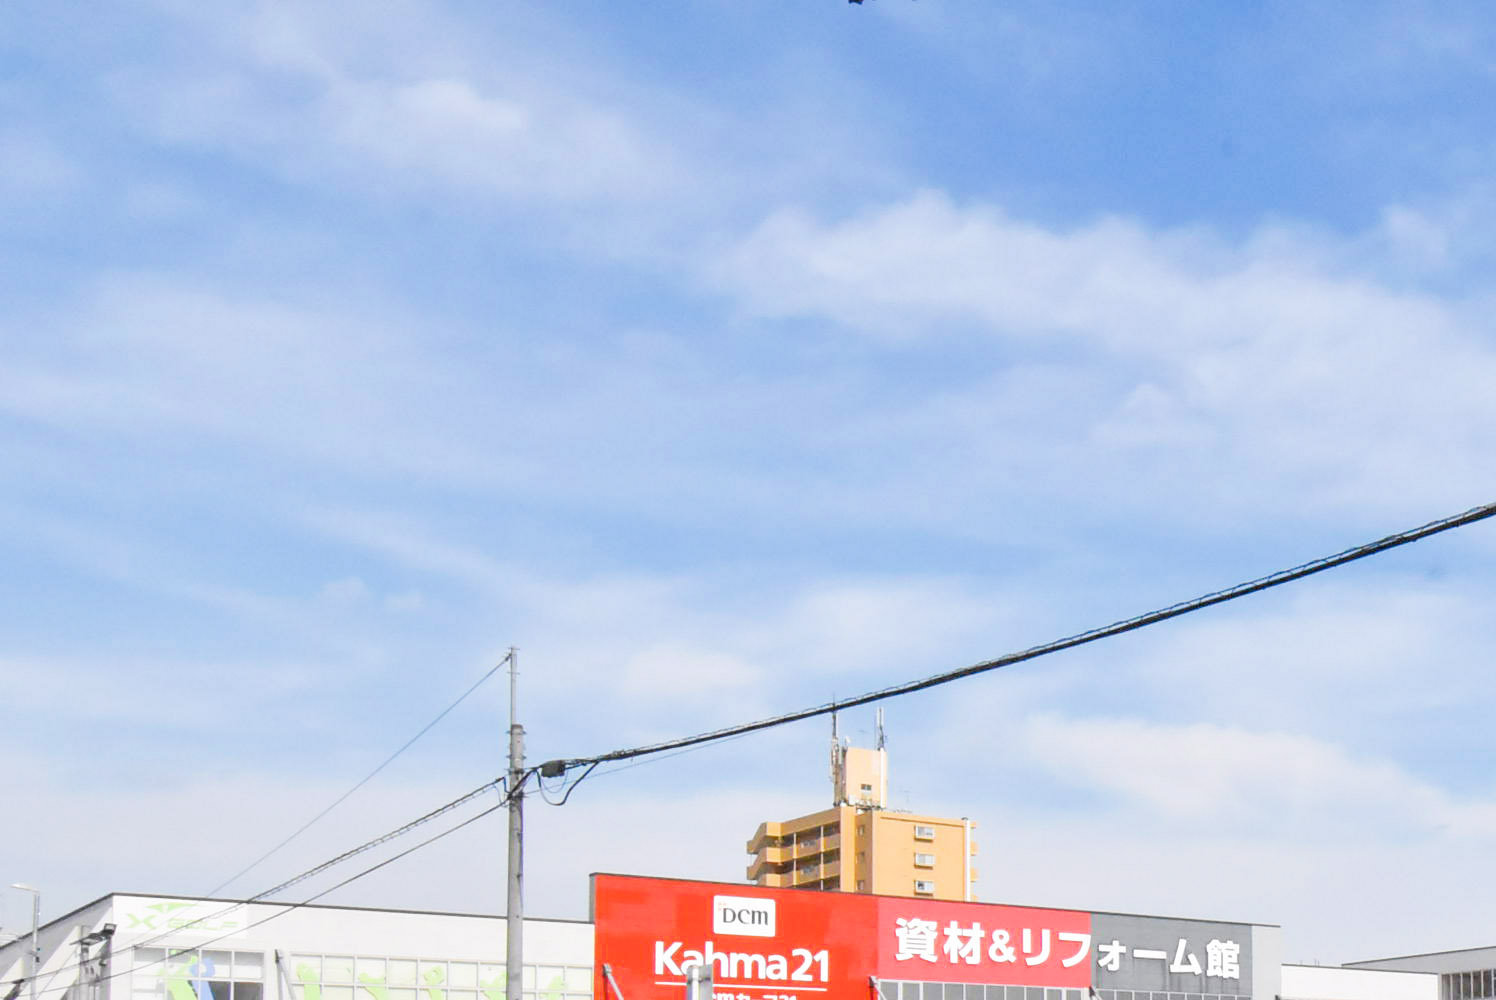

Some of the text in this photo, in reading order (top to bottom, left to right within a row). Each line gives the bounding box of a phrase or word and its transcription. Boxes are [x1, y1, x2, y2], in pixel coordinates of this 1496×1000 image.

[895, 917, 1240, 980] 資材&リフォーム館
